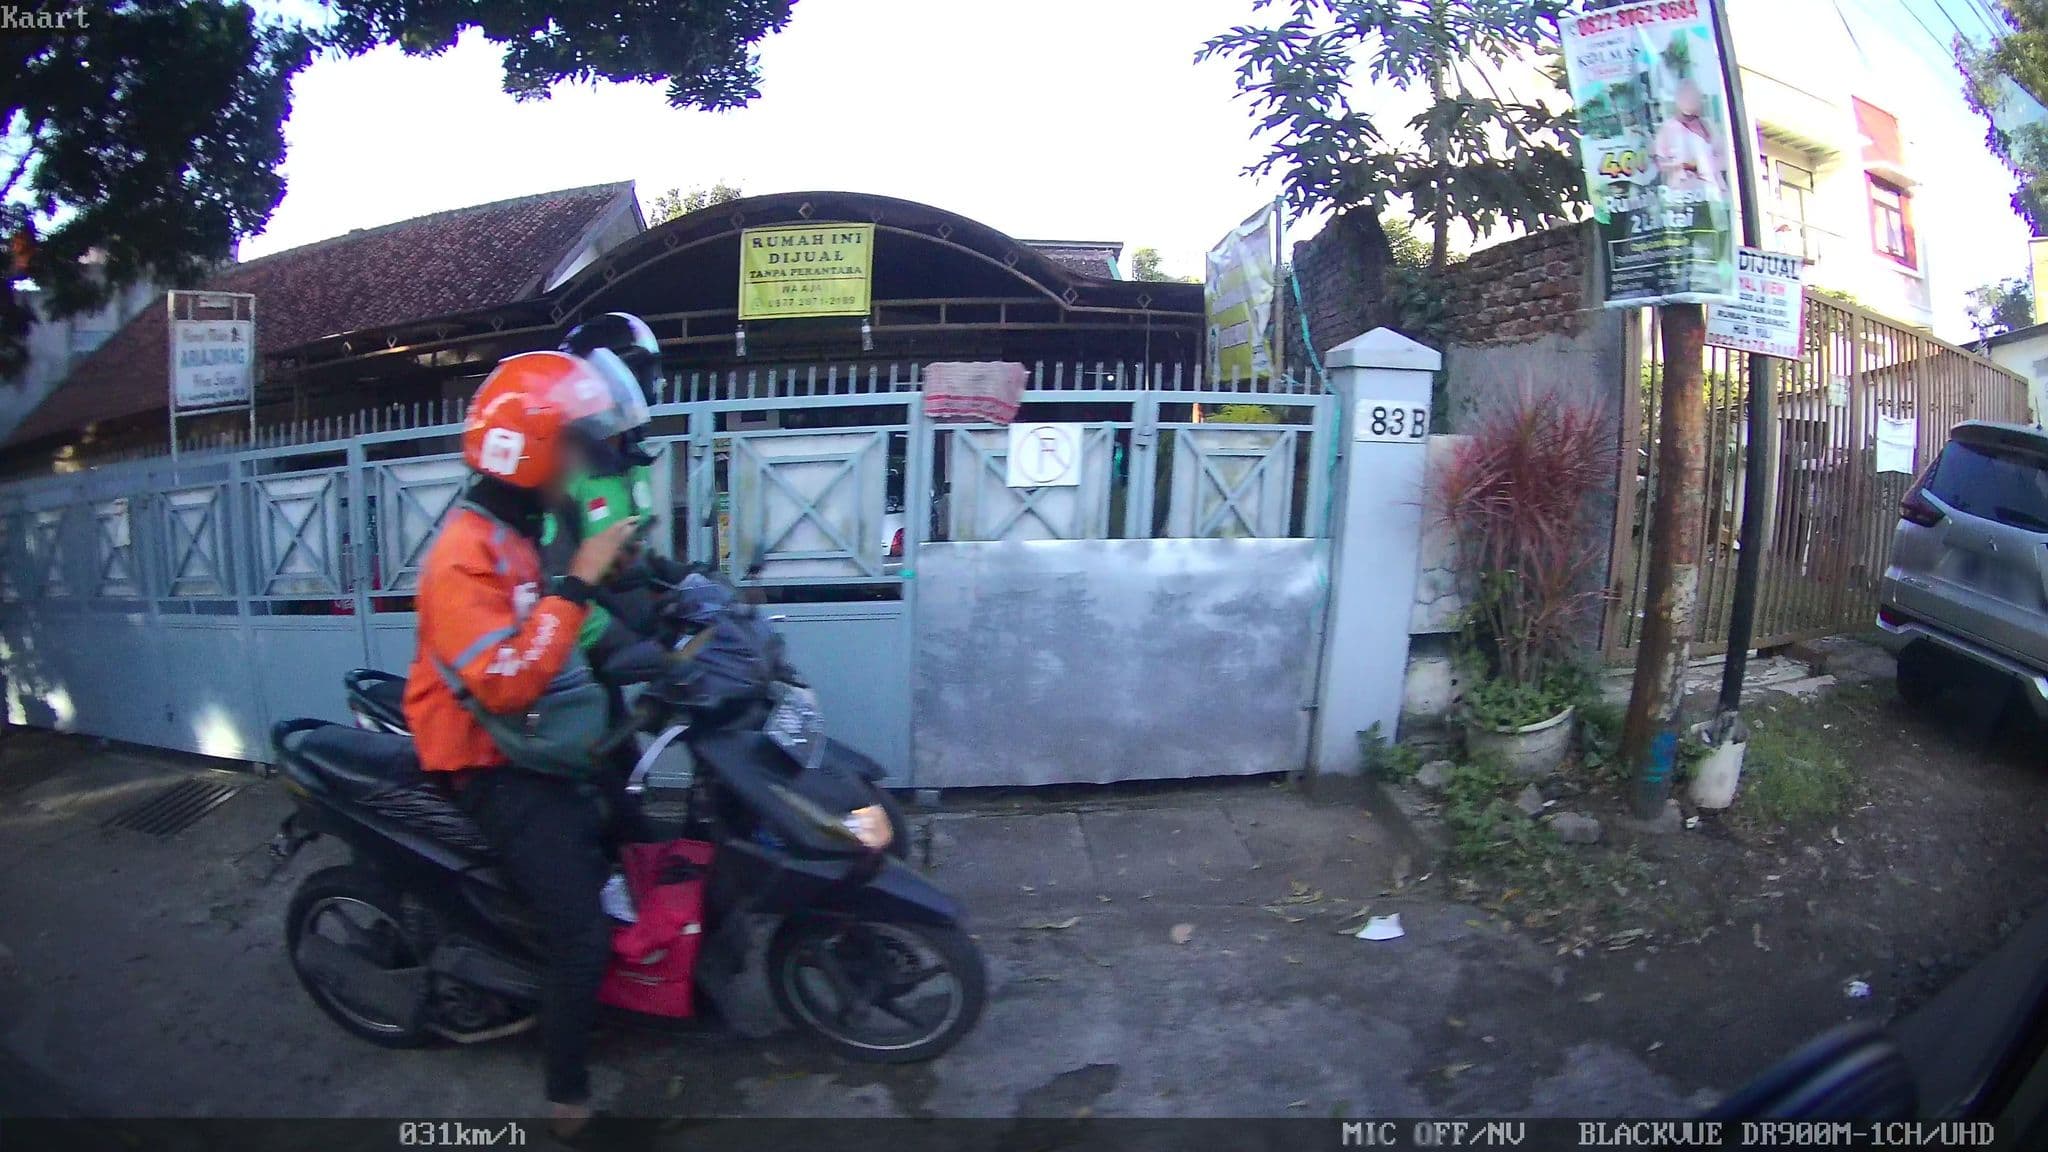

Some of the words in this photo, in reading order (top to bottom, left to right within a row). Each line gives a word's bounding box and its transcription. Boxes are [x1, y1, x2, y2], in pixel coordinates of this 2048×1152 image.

[752, 234, 824, 248] RUMAH
[831, 232, 862, 245] INI
[768, 250, 845, 264] DIJUAL
[1739, 250, 1800, 280] DIJUAL
[749, 268, 787, 279] TANPA
[790, 266, 862, 277] PERANTARA
[1372, 406, 1425, 438] 83B
